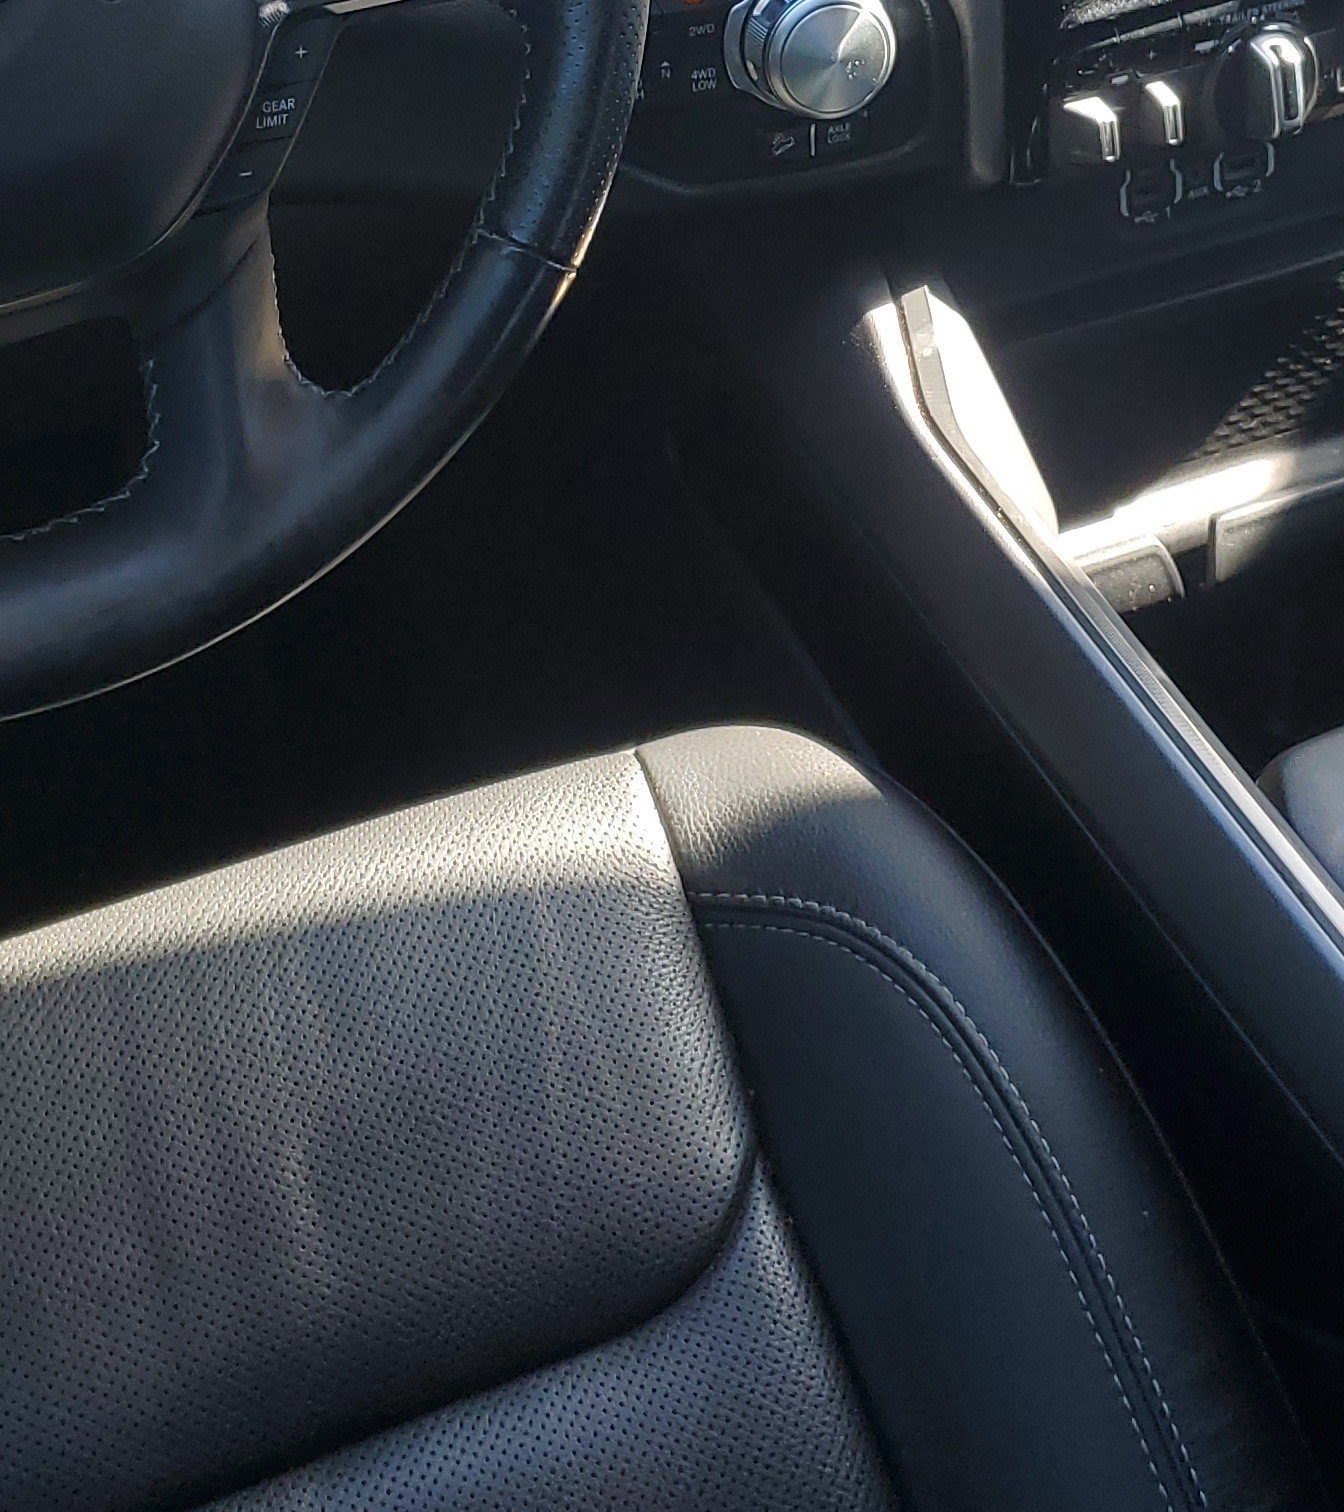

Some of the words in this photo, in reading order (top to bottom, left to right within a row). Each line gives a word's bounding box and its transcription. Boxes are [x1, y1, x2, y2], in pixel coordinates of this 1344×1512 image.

[689, 23, 715, 37] 2WD
[690, 67, 716, 81] 4WD
[692, 80, 717, 92] LOW
[262, 98, 296, 113] GEAR
[256, 113, 290, 129] LIMIT
